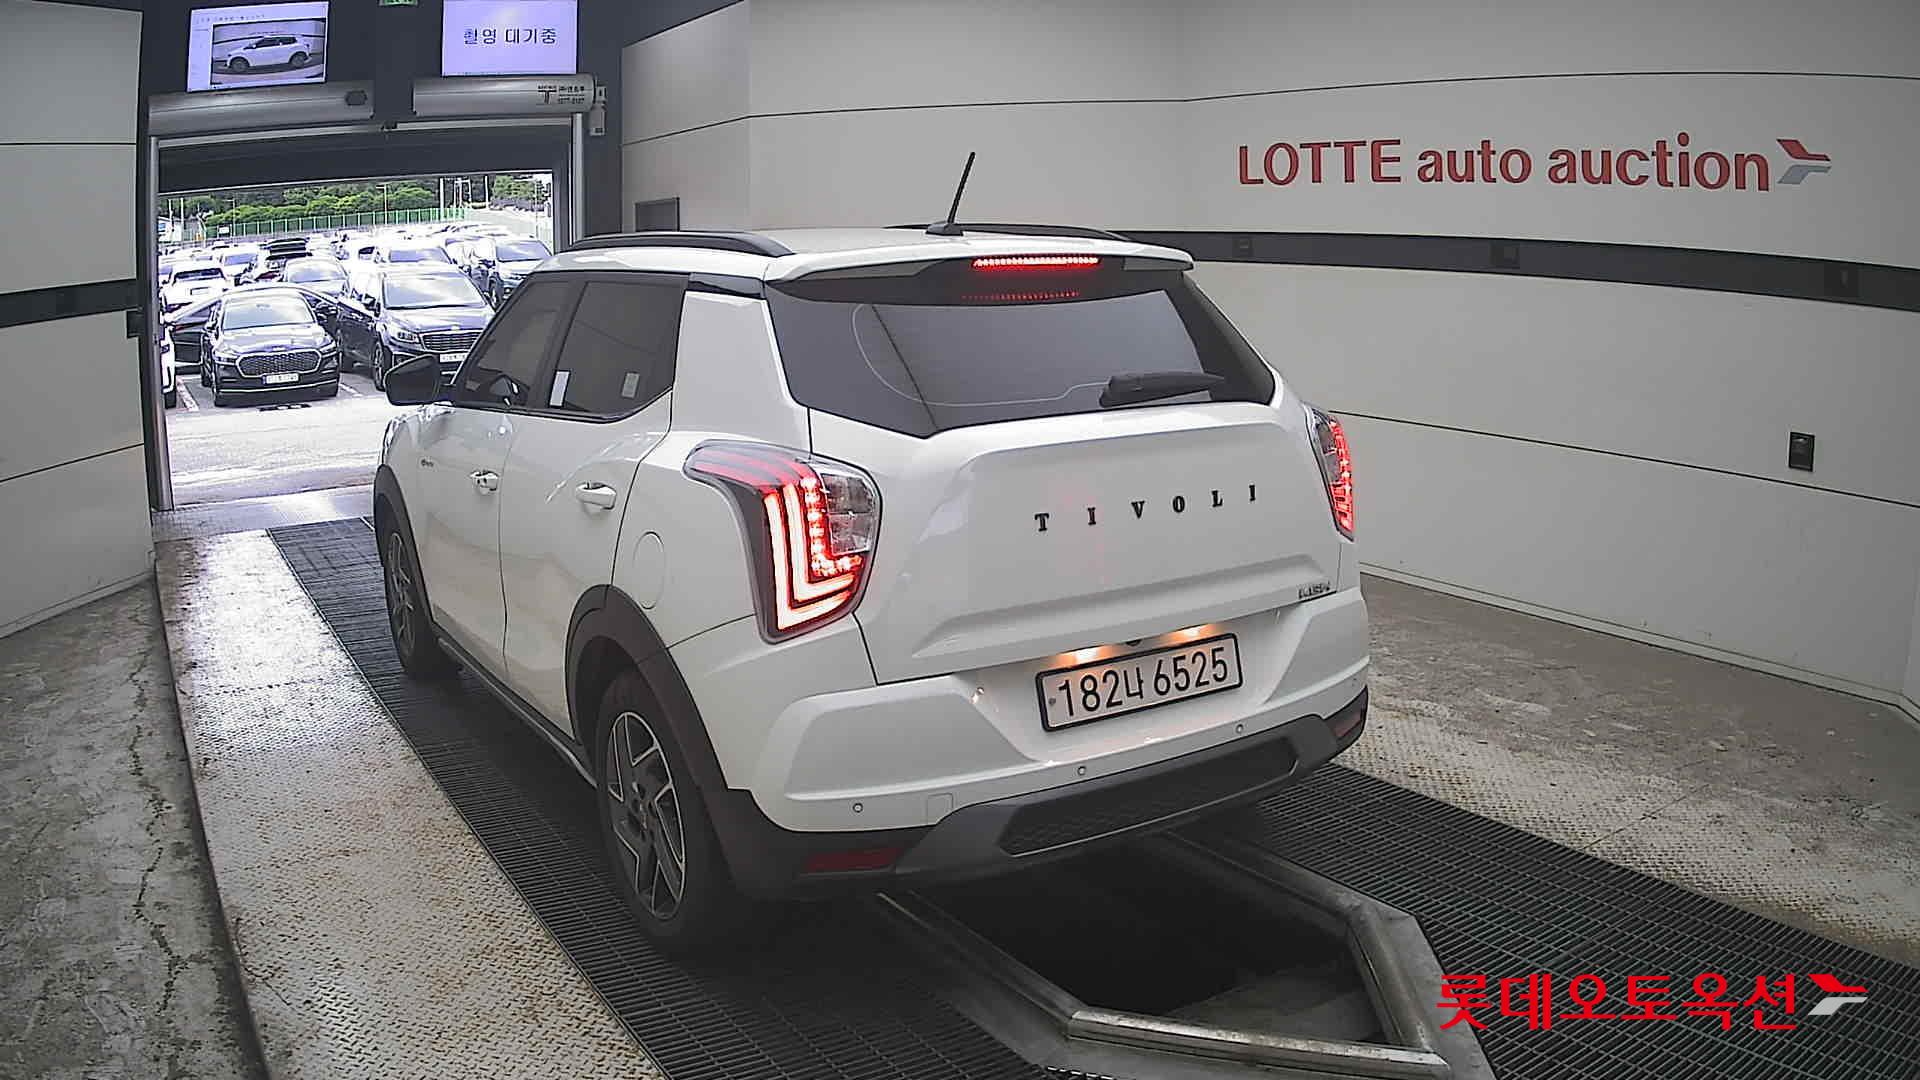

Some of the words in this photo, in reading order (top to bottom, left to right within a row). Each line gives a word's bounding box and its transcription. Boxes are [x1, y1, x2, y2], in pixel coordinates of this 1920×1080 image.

[505, 28, 557, 44] 대기중
[1239, 139, 1401, 185] LOTTE
[1417, 139, 1532, 184] auto
[1548, 132, 1770, 191] auction
[1034, 485, 1257, 532] TIVOLI
[1058, 667, 1144, 717] 182나
[1153, 647, 1229, 696] 6525
